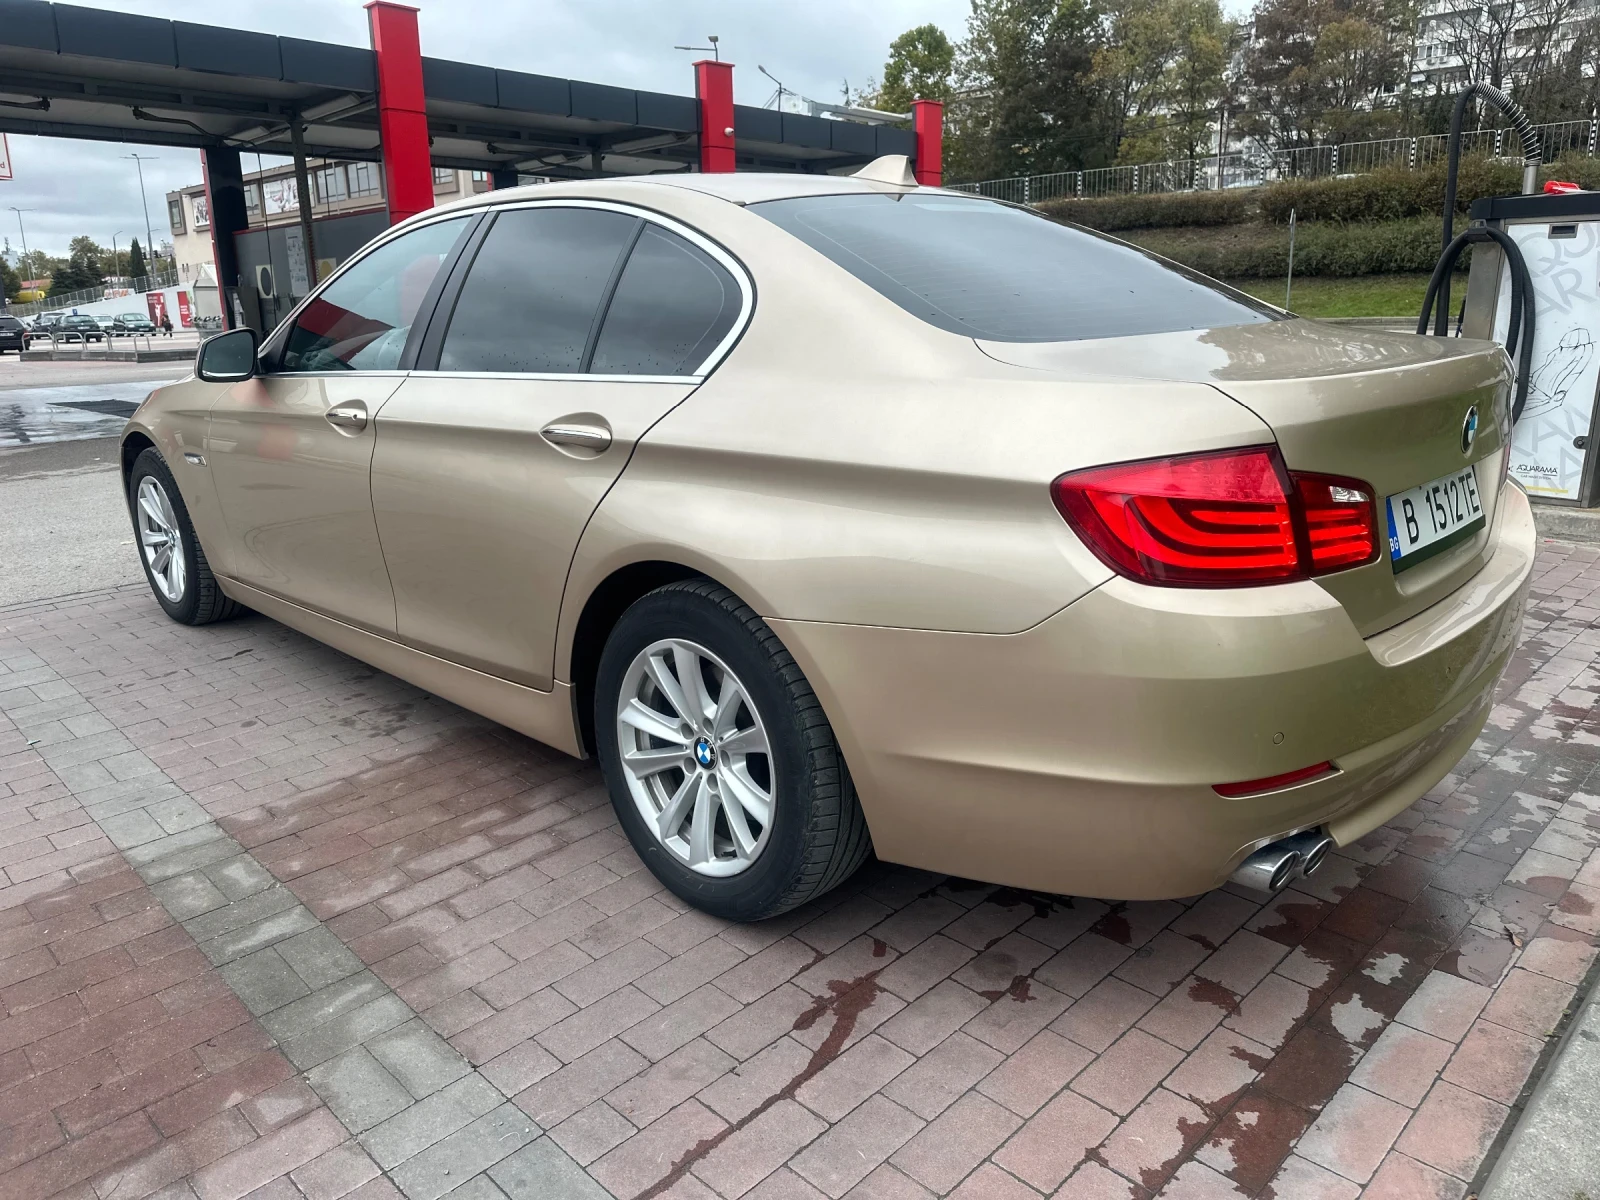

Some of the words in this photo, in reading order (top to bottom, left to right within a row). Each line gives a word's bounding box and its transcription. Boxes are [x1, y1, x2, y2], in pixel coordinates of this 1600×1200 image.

[1516, 464, 1558, 474] AQUARAMA
[1402, 498, 1419, 546] B
[1389, 536, 1399, 552] BG
